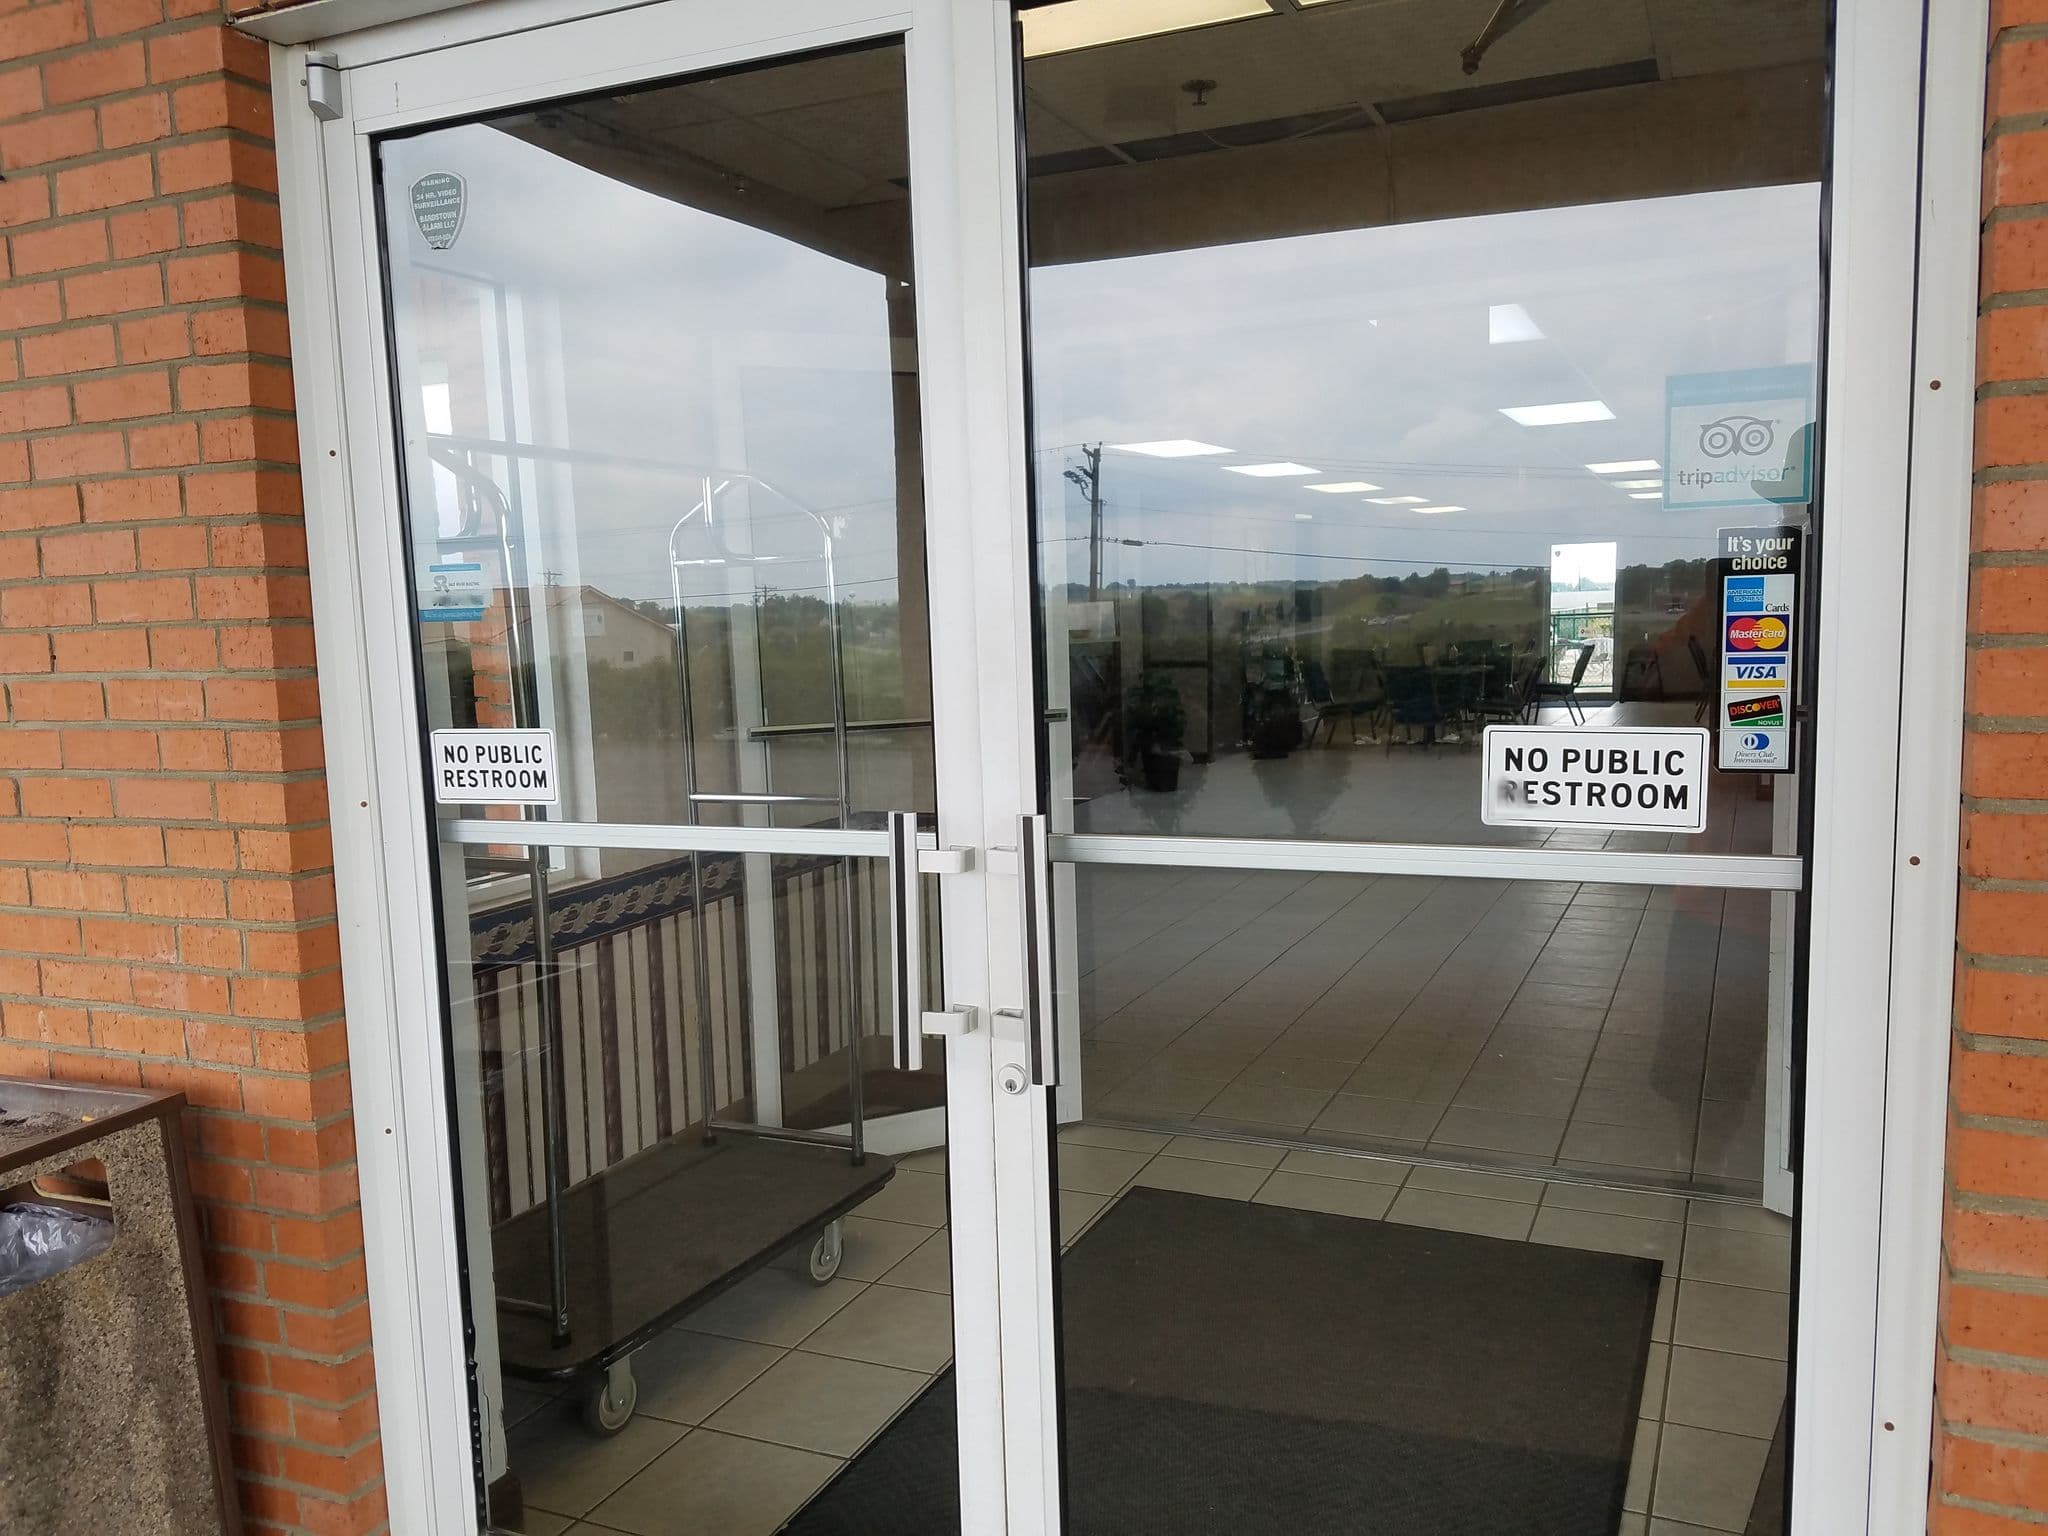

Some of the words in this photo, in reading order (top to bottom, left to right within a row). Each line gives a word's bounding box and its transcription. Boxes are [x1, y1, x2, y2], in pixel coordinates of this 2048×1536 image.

[421, 177, 450, 186] WARNING
[437, 189, 456, 197] VIDEO
[414, 197, 460, 209] SURVEILLANCE
[1727, 535, 1752, 553] It's
[1755, 537, 1795, 555] your
[1731, 554, 1788, 571] choice
[1727, 588, 1763, 596] AMERICAN
[1765, 602, 1790, 613] Cards
[1729, 628, 1785, 640] MasterCard
[1736, 666, 1777, 679] VISA
[1729, 699, 1780, 716] DISCOVER
[443, 745, 469, 764] NO
[475, 745, 543, 764] PUBLIC
[1758, 750, 1775, 758] Club
[1504, 747, 1548, 773] NO
[1561, 748, 1685, 776] PUBLIC
[443, 769, 548, 789] RESTROOM
